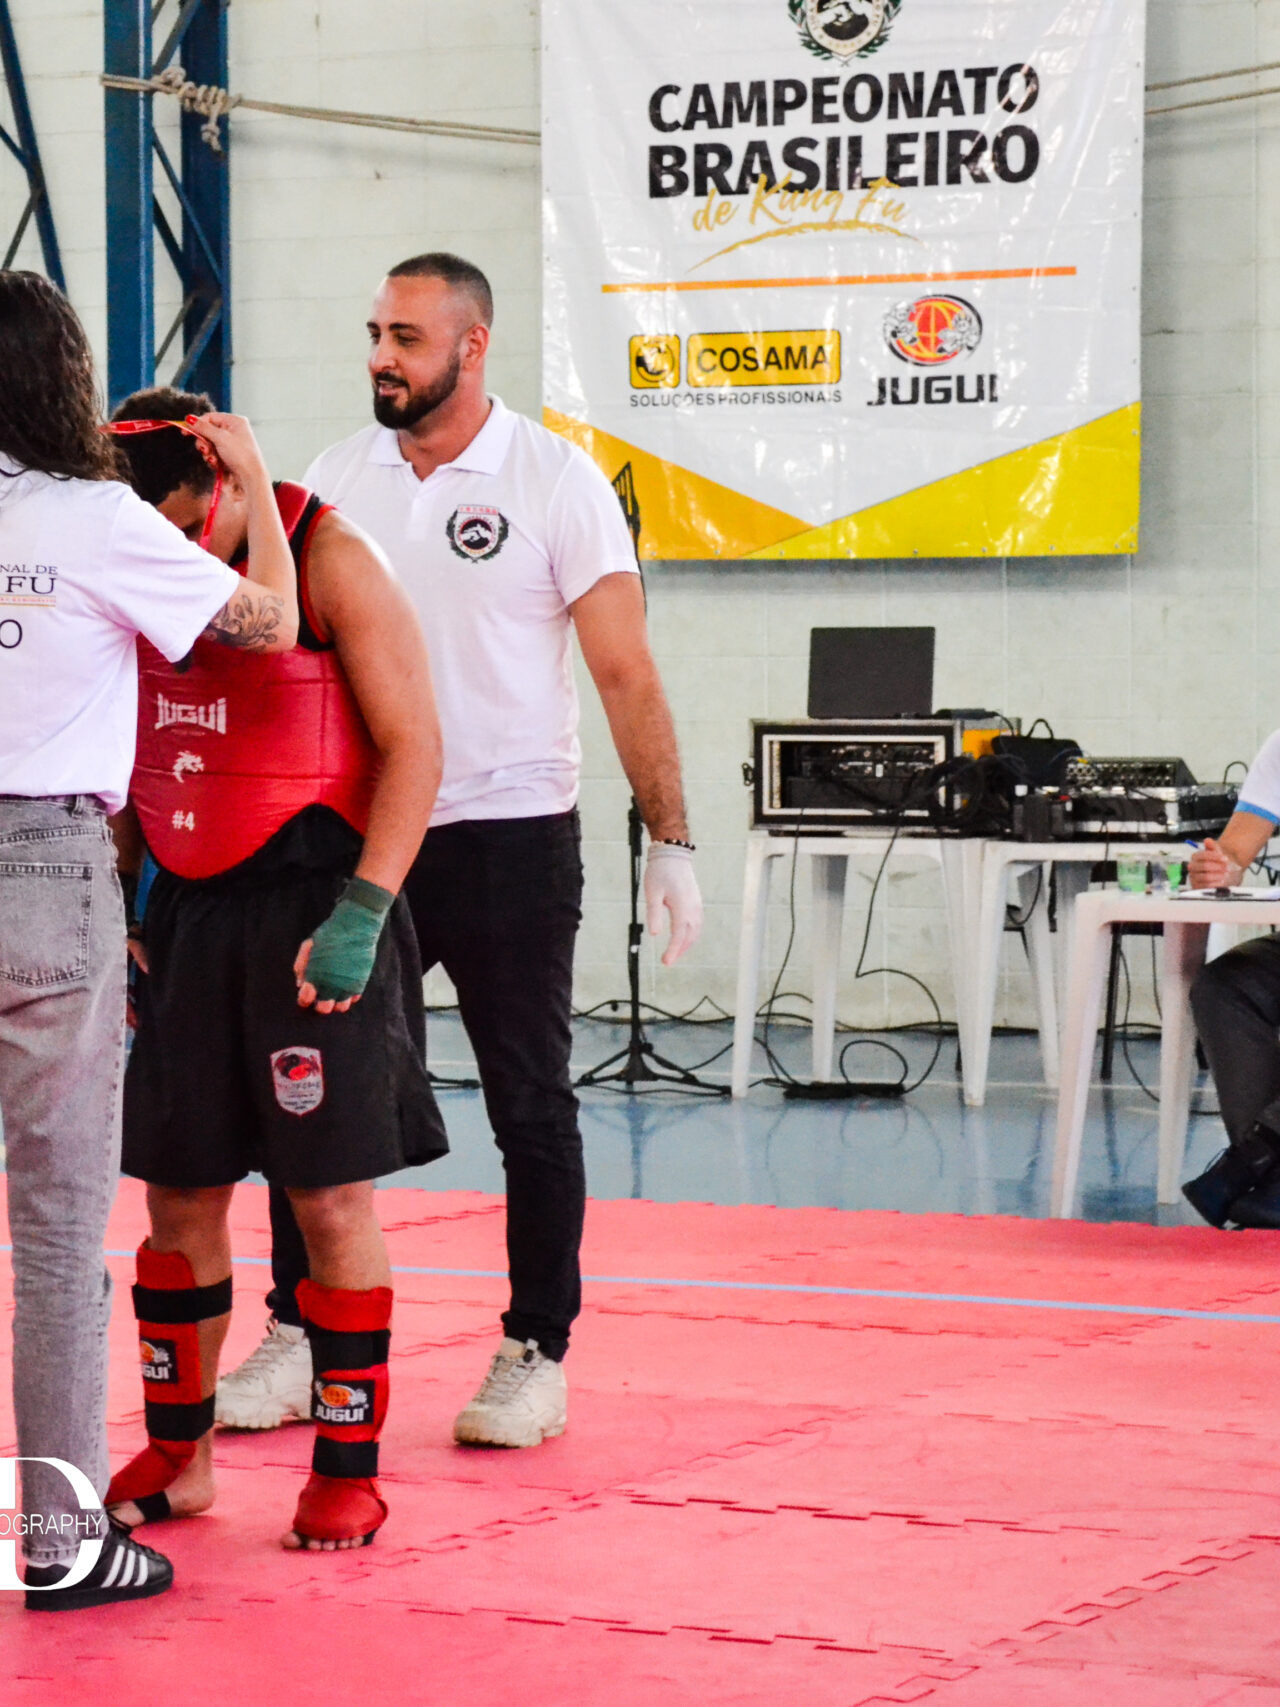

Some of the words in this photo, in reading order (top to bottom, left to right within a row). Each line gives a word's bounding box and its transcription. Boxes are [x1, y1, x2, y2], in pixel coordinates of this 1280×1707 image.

[648, 63, 1040, 133] CAMPEONATO
[648, 124, 1040, 199] BRASILEIRO
[693, 188, 739, 232] de
[749, 171, 844, 225] Kung
[854, 176, 910, 222] Fu
[696, 345, 832, 374] COSAMA
[866, 373, 999, 406] JUGUI
[34, 564, 58, 576] DE
[5, 575, 57, 595] FU
[172, 810, 195, 832] #4
[142, 1364, 169, 1380] GUI
